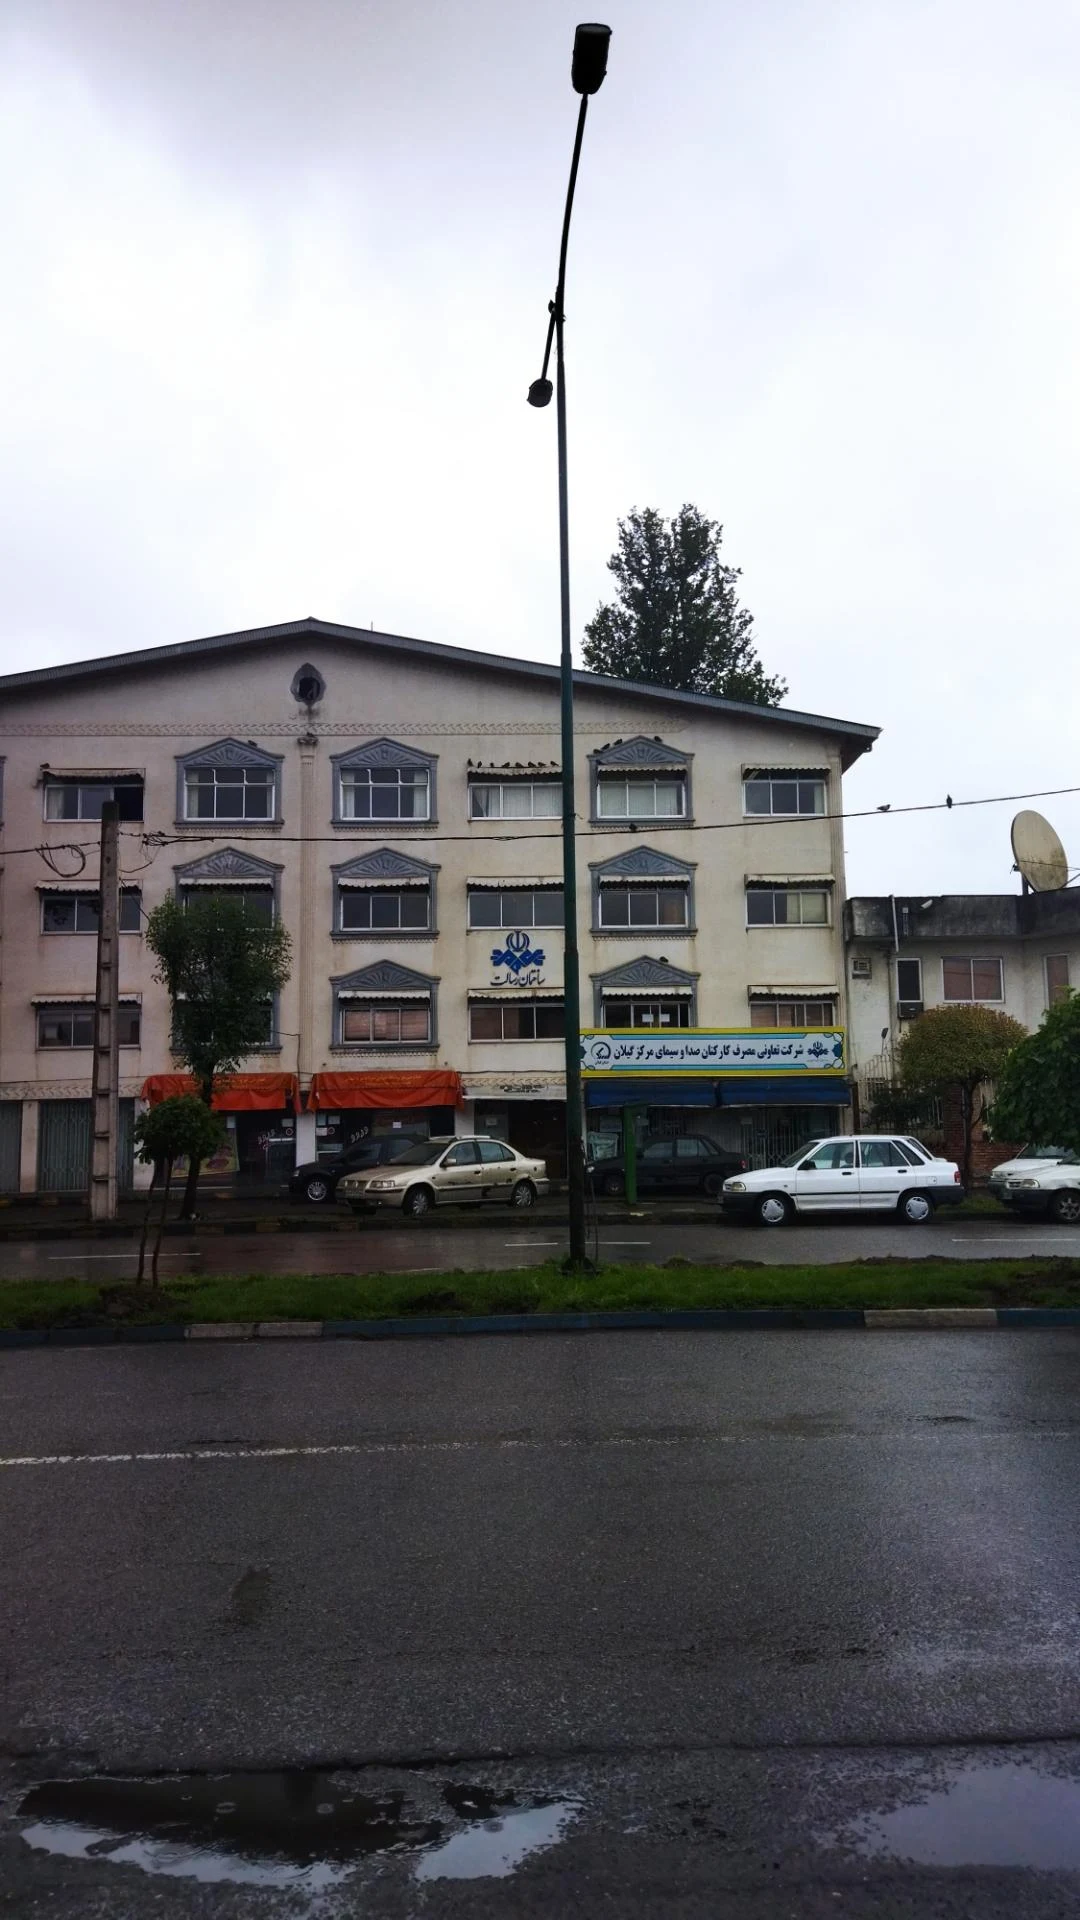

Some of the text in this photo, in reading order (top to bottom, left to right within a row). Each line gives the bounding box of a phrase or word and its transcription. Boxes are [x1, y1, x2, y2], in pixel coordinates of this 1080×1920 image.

[490, 969, 546, 987] ساختمان رسالت
[613, 1044, 635, 1060] گیلان
[635, 1044, 655, 1060] مرکز
[655, 1044, 678, 1060] سیمای
[679, 1047, 685, 1060] و
[685, 1044, 701, 1056] صدا
[733, 1043, 756, 1059] مصرف
[757, 1044, 779, 1060] تعاونی
[781, 1044, 804, 1058] شرکت
